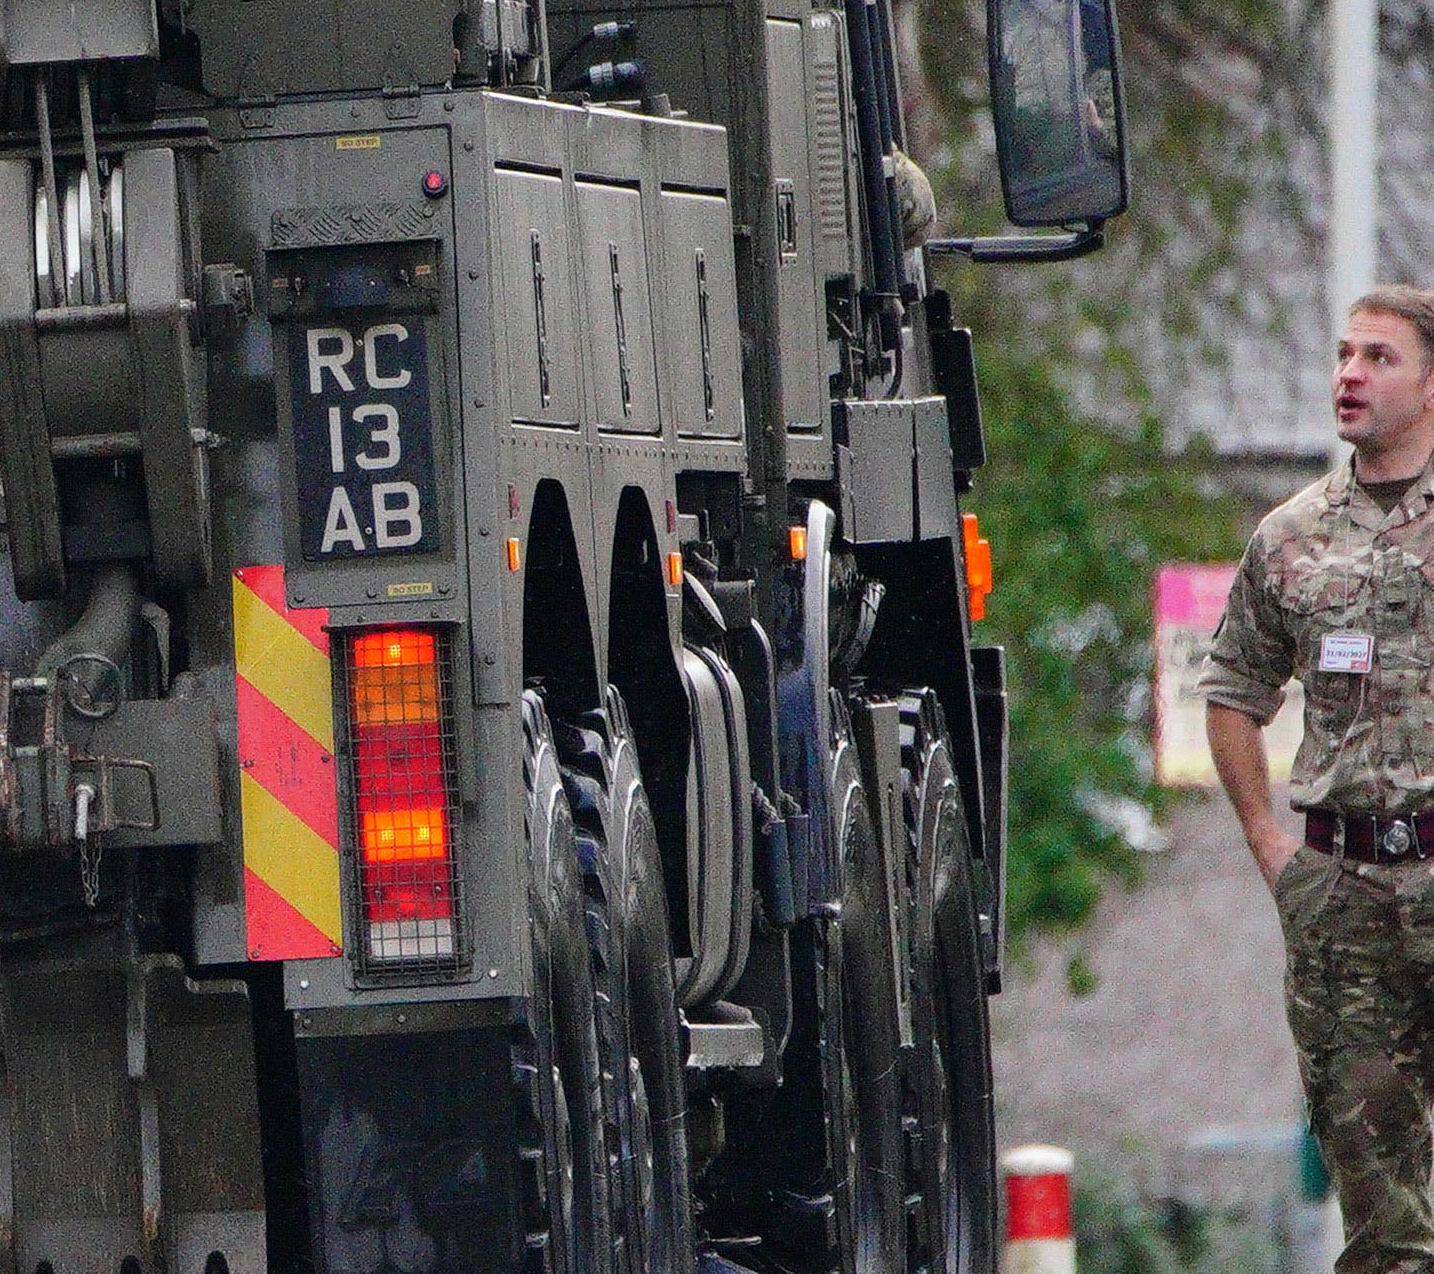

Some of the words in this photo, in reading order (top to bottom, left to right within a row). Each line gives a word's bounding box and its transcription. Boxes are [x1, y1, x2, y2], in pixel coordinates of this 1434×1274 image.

[307, 322, 412, 395] RC
[327, 403, 402, 473] 13
[320, 481, 422, 553] AB
